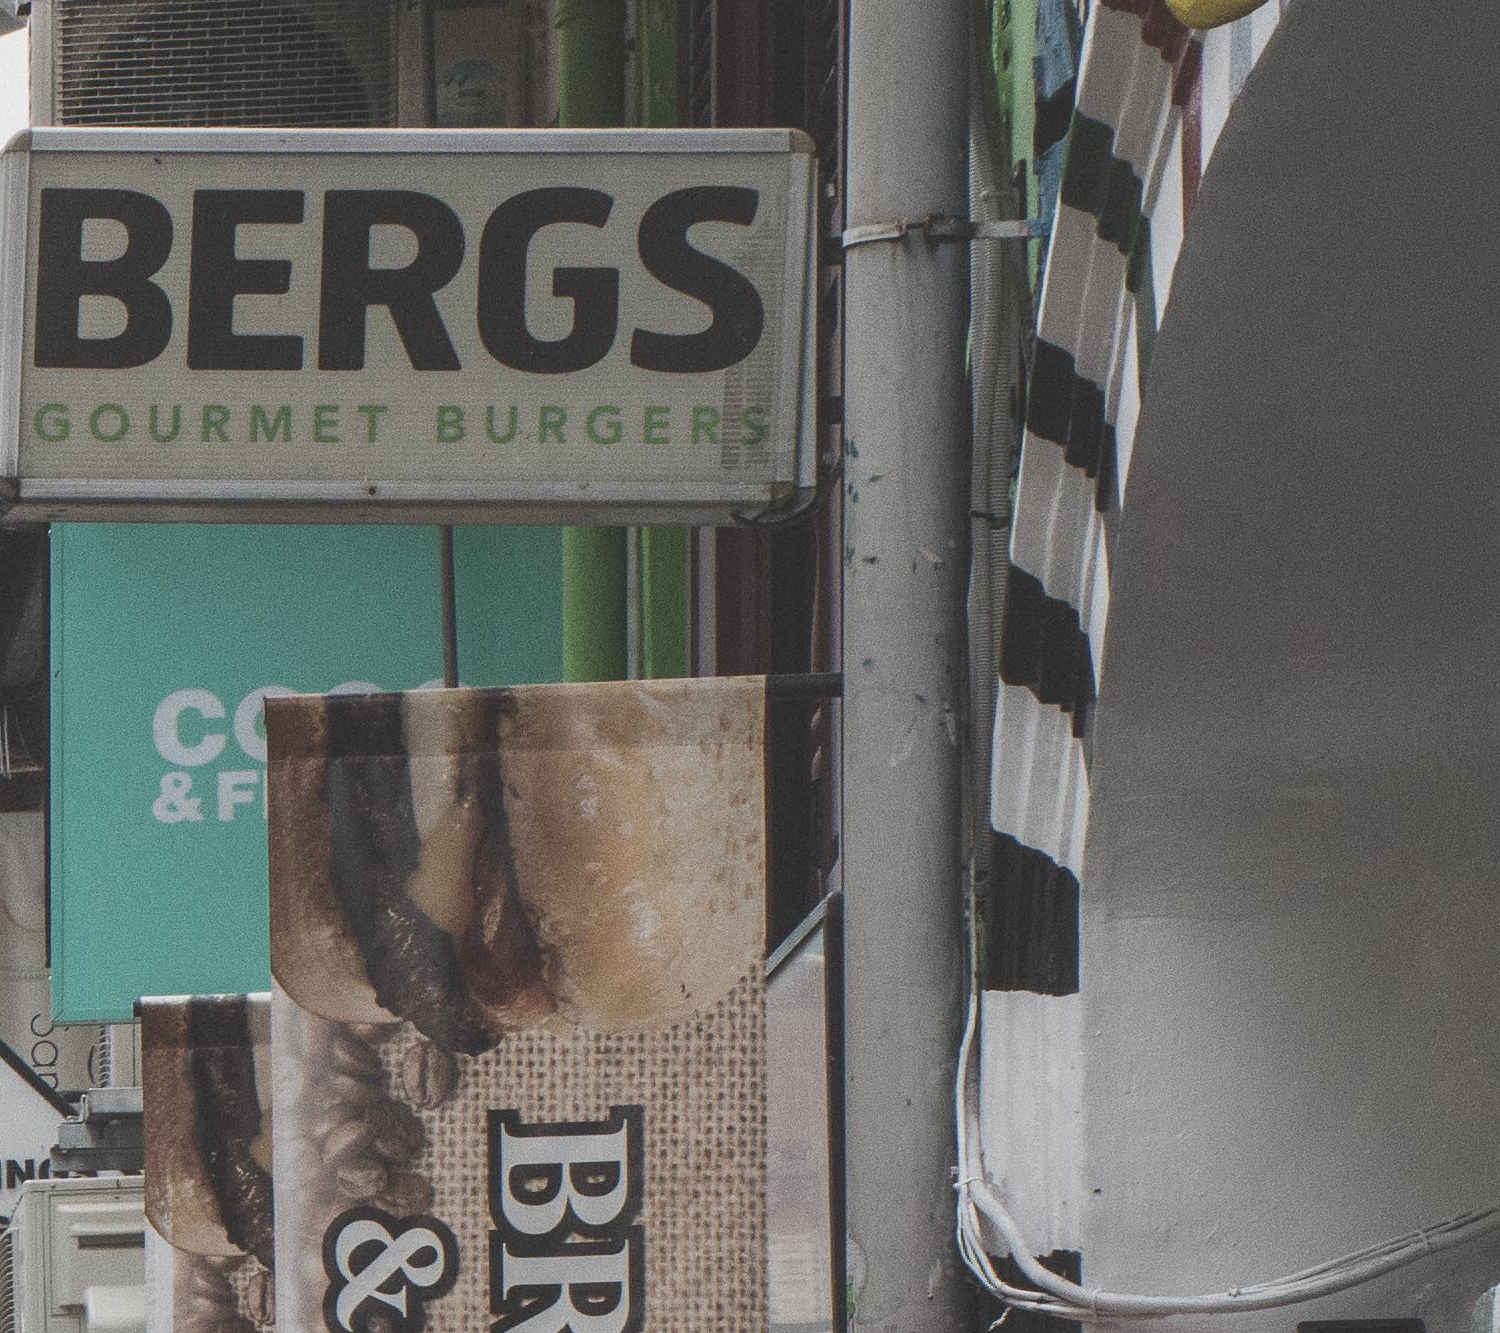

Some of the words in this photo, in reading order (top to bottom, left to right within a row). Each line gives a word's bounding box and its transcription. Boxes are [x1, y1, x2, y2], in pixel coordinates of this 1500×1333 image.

[33, 187, 766, 374] BERGS
[34, 403, 388, 444] GOURMET
[436, 403, 770, 447] BURGERS
[152, 771, 204, 823] &
[217, 771, 267, 823] F
